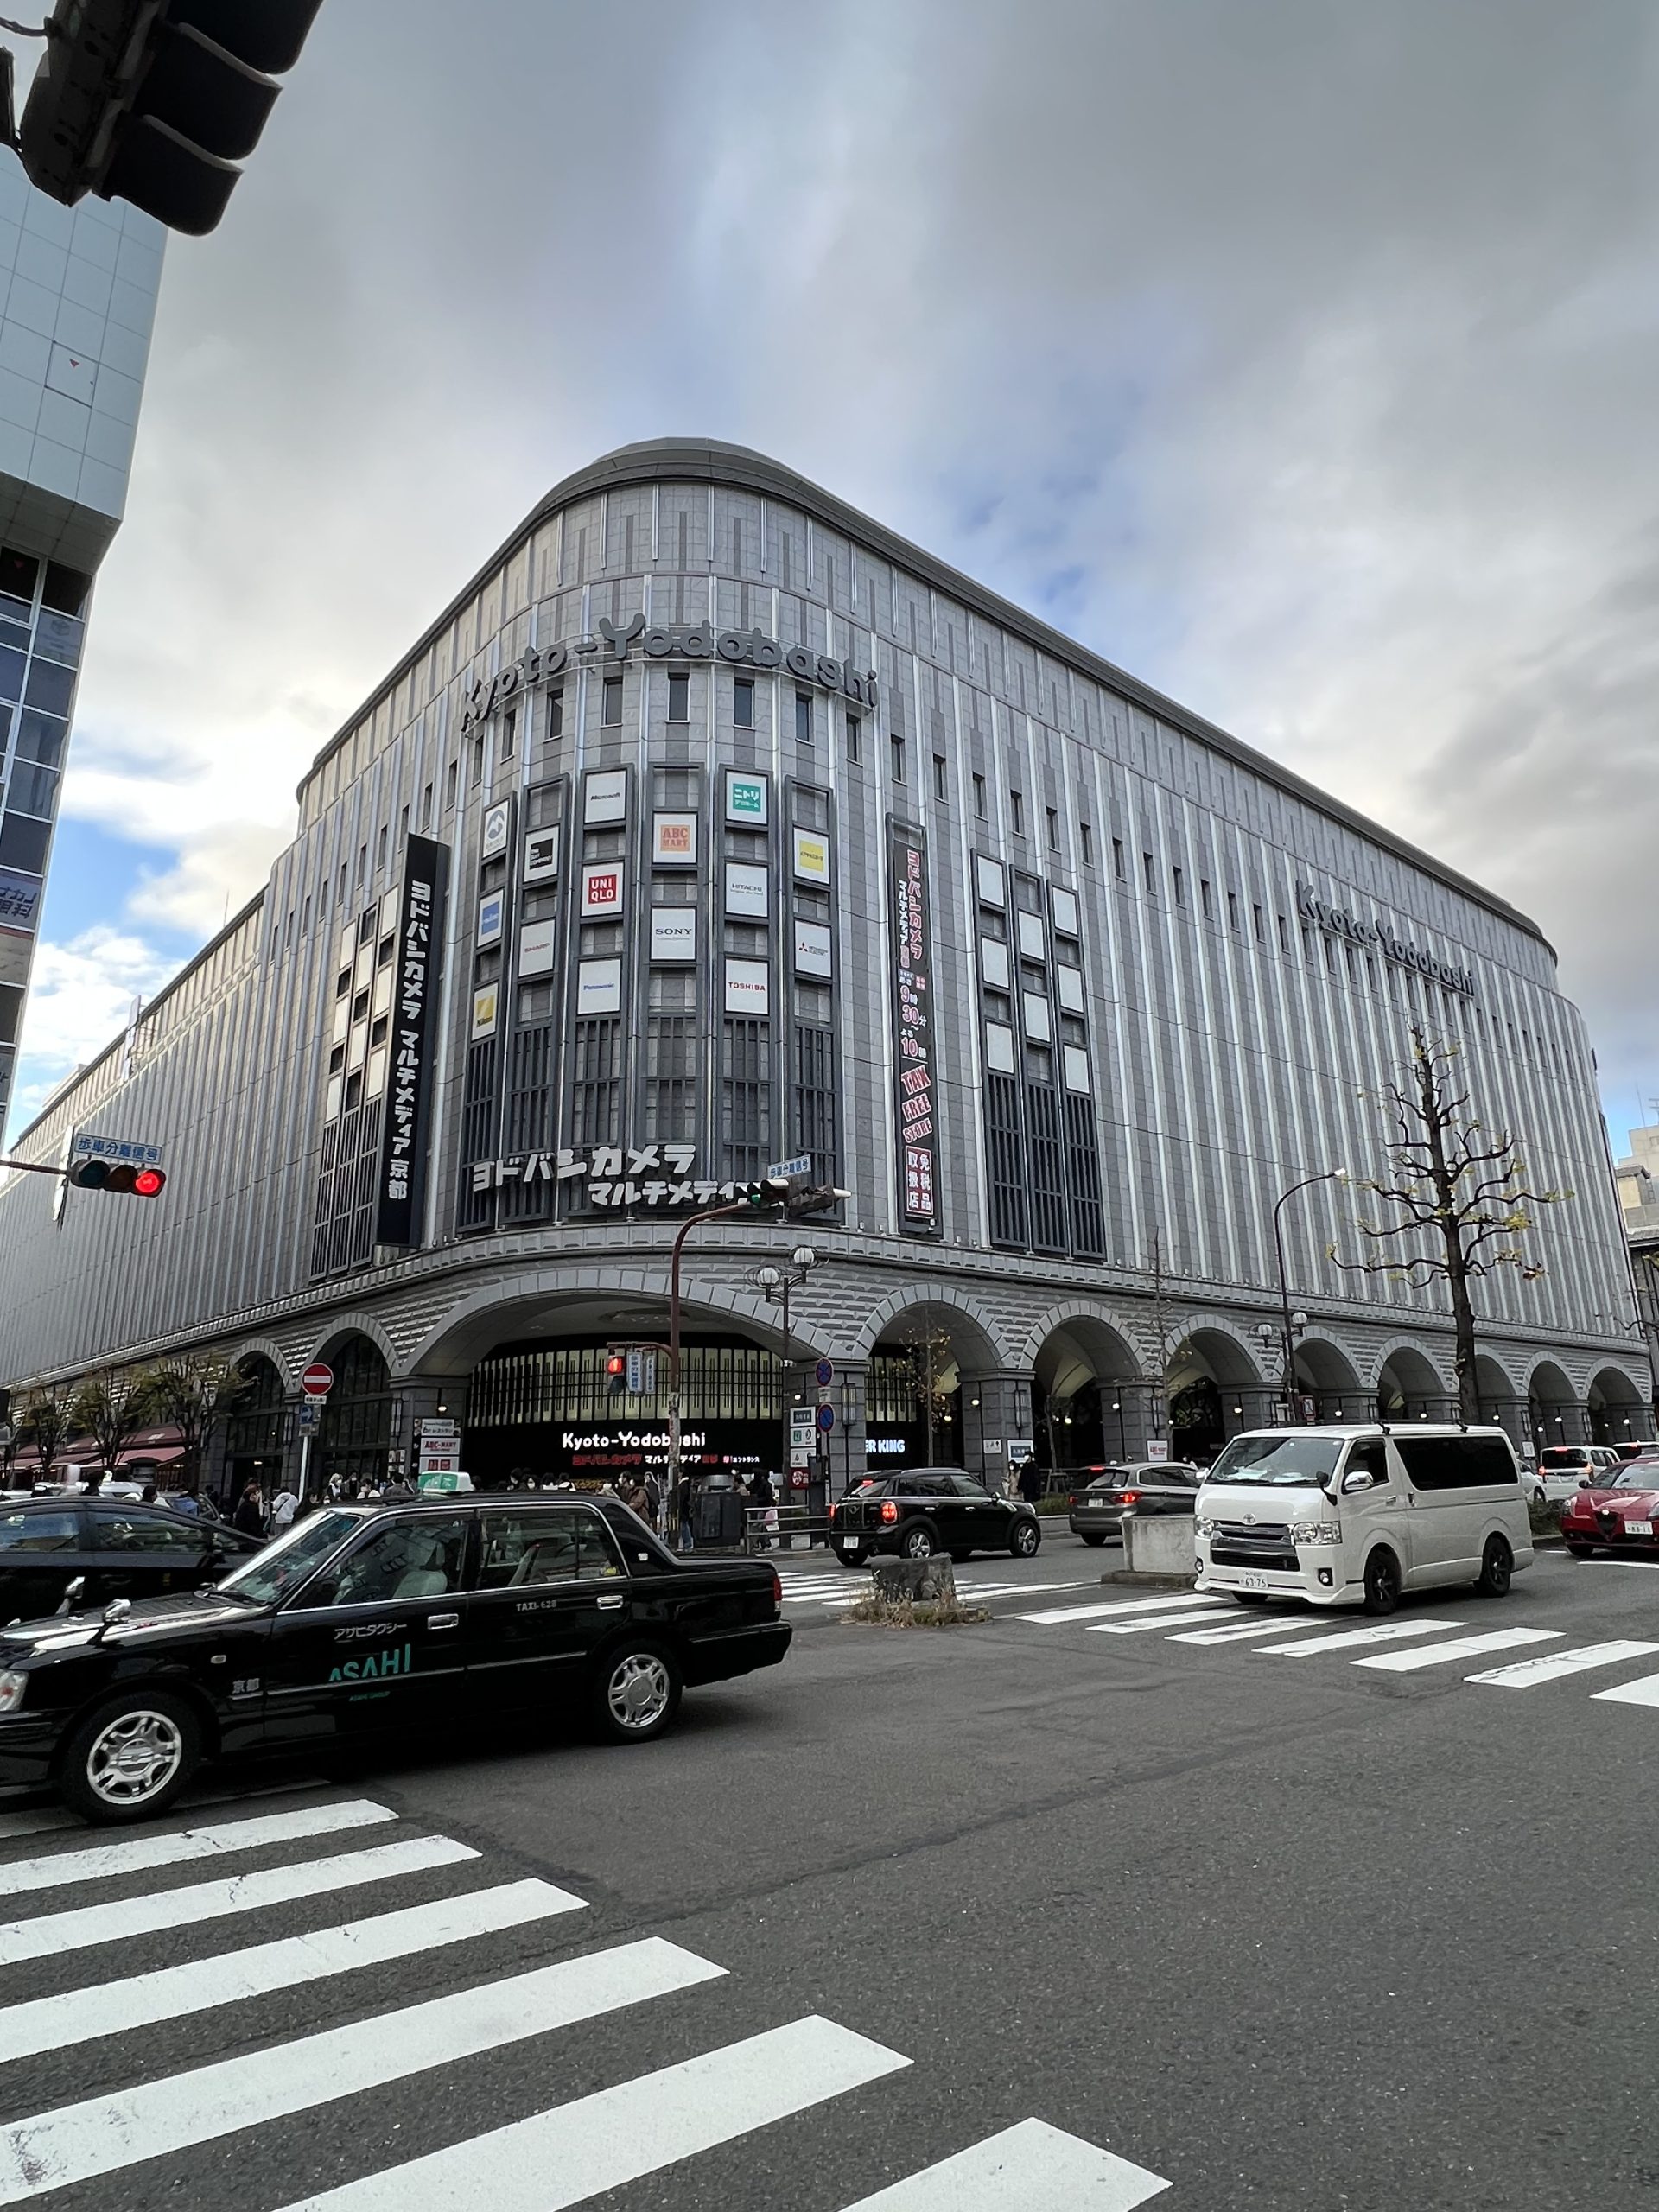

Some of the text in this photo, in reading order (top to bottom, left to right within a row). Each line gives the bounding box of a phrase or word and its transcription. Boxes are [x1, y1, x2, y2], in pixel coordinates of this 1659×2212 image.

[461, 613, 879, 731] Kyoto-Yodobashi
[591, 791, 620, 801] Microsoft
[734, 788, 760, 801] ニトリ
[663, 827, 688, 838] ABC
[591, 878, 613, 889] UNI
[732, 883, 762, 892] HITACHI
[591, 890, 614, 901] QLO
[907, 849, 923, 960] ヨドバシカメラ
[1296, 879, 1474, 996] Kyoto-Yodobashi
[524, 942, 550, 953] SHARP
[728, 982, 766, 991] TOSHIBA
[388, 880, 431, 1200] ヨドバシカメラ マルチメディア 京都
[901, 1064, 931, 1096] TAX
[902, 1092, 931, 1122] FREE
[903, 1117, 932, 1144] STORE
[78, 1137, 158, 1161] 歩車分離信号
[473, 1143, 696, 1192] ヨドバシカメラ
[919, 1153, 931, 1211] 免税品
[562, 1431, 706, 1451] Kyoto-Yodobshi
[878, 1439, 906, 1453] KING
[334, 1622, 408, 1640] アサヒタクシー
[232, 1677, 259, 1694] 京都
